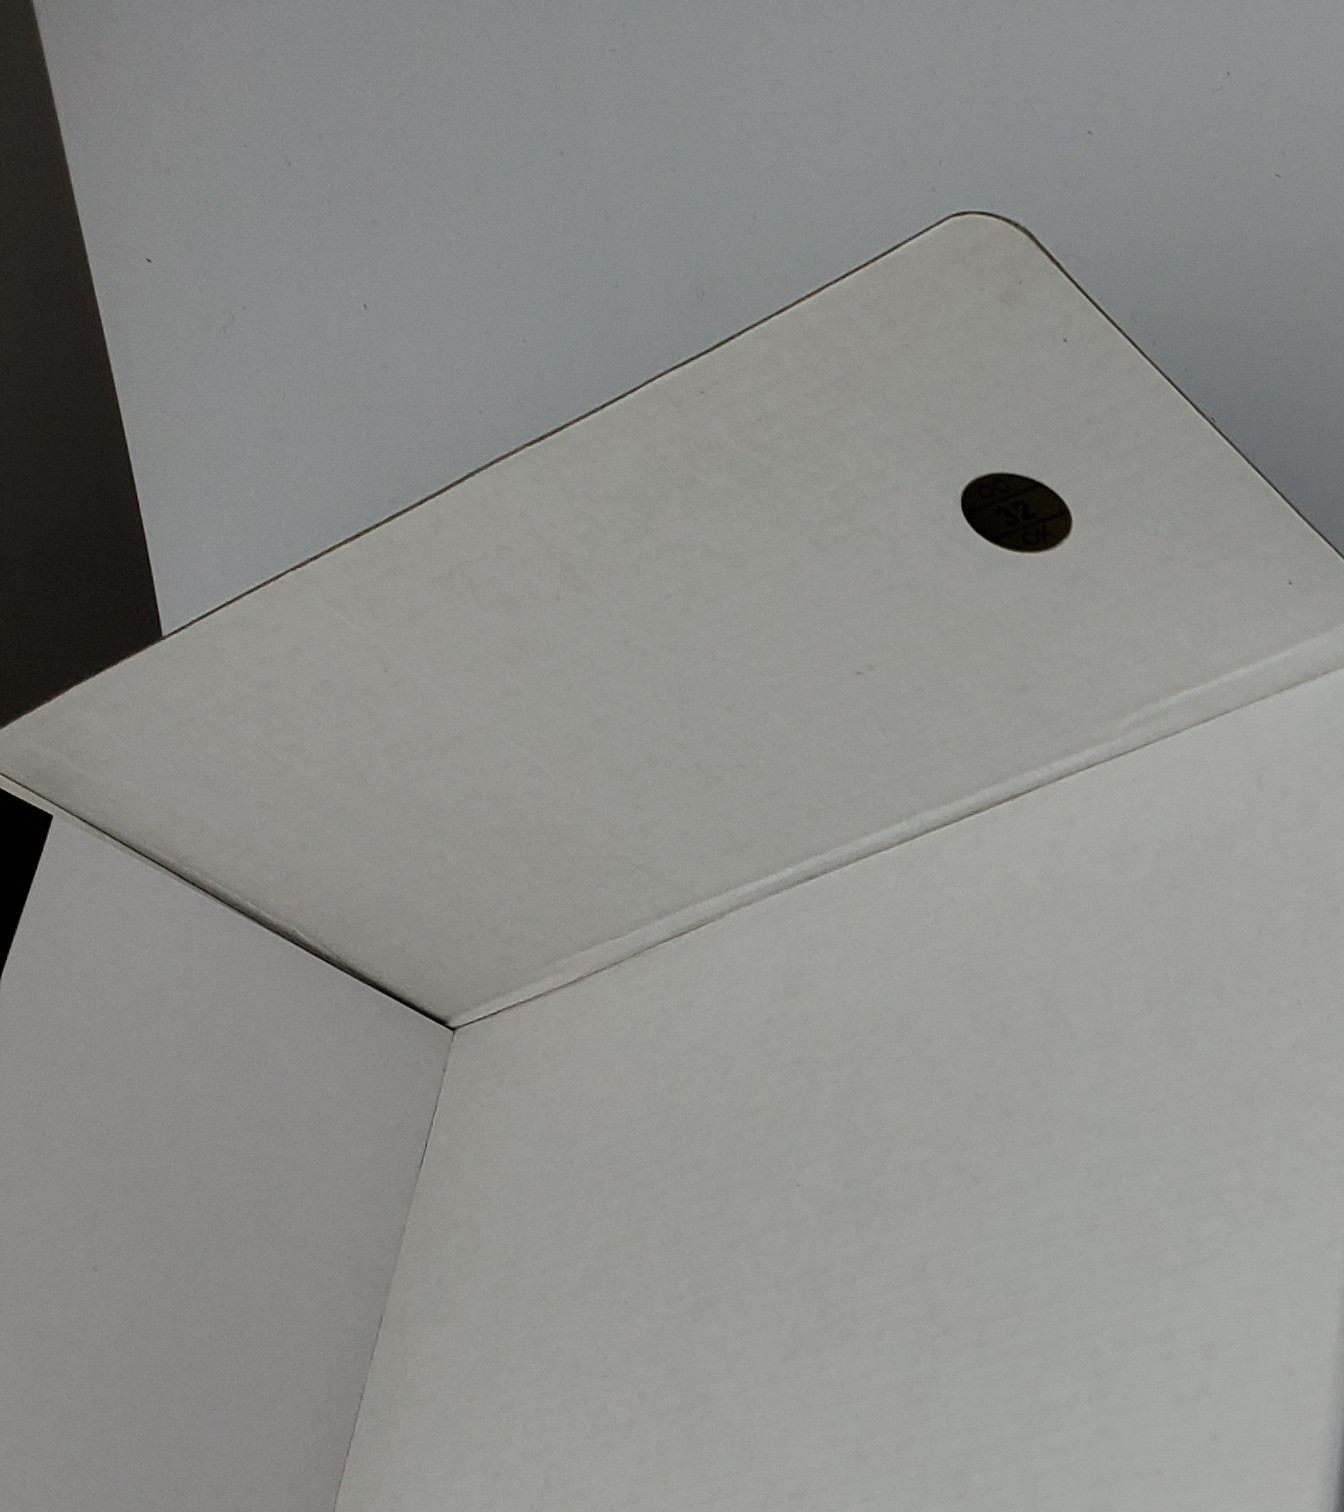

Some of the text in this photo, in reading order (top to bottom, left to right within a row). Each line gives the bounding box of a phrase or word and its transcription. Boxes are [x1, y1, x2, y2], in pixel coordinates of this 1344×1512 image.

[977, 478, 1011, 498] QC
[994, 500, 1037, 525] 32
[1020, 524, 1055, 543] OK
